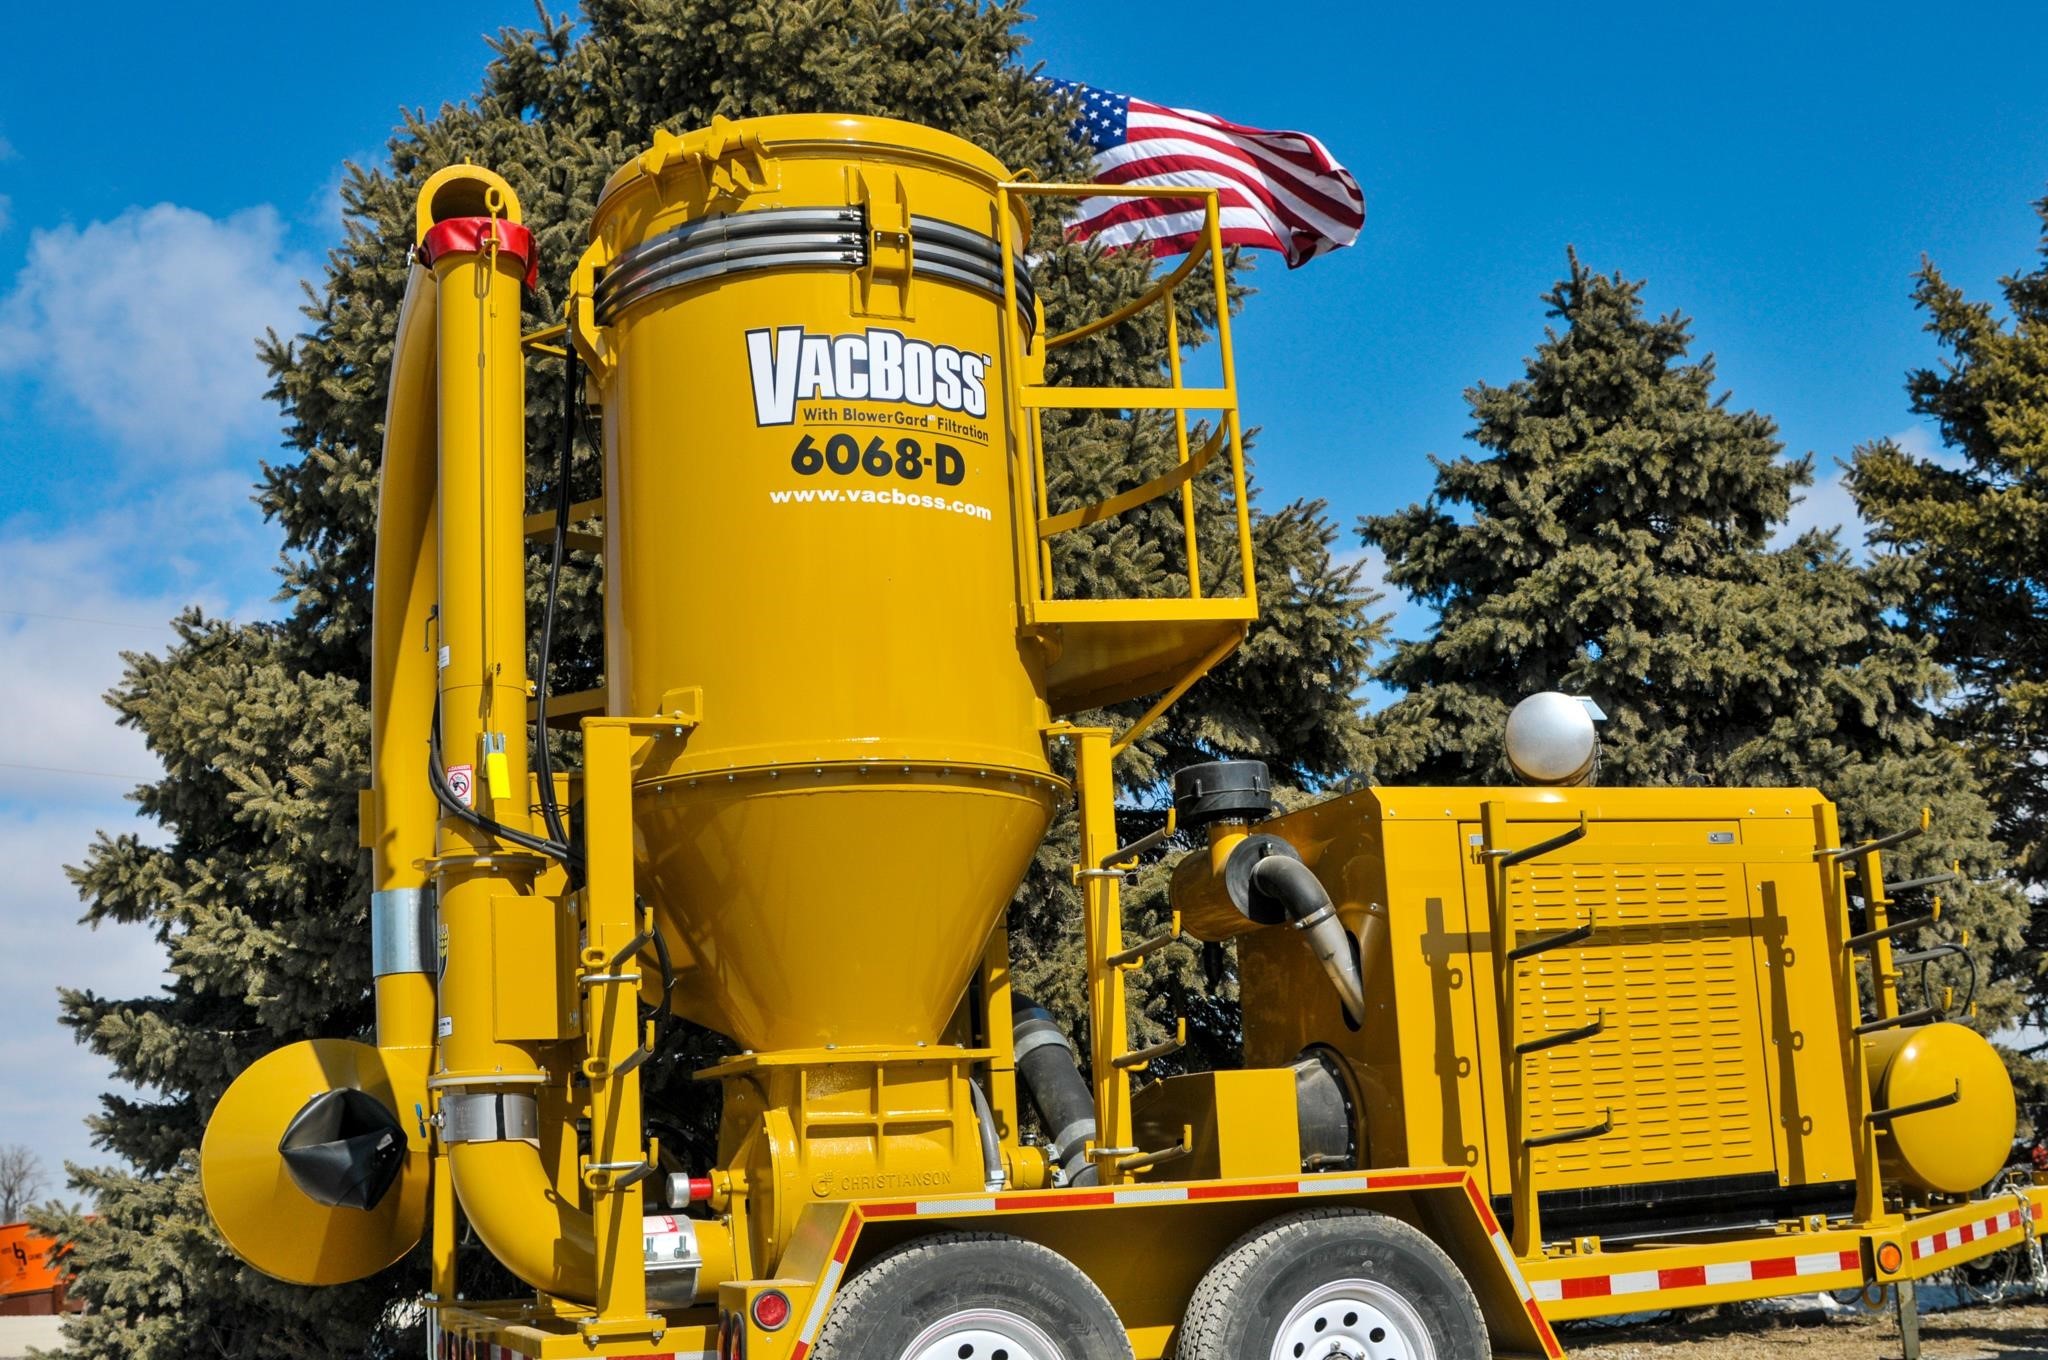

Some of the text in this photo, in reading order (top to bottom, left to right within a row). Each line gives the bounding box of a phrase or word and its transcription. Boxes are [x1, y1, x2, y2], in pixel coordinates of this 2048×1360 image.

[803, 408, 838, 421] With
[937, 417, 989, 441] Filtration
[791, 433, 966, 486] 6068-D
[769, 488, 992, 520] www.vacboss.com
[841, 1171, 951, 1190] CHRISTIANSON
